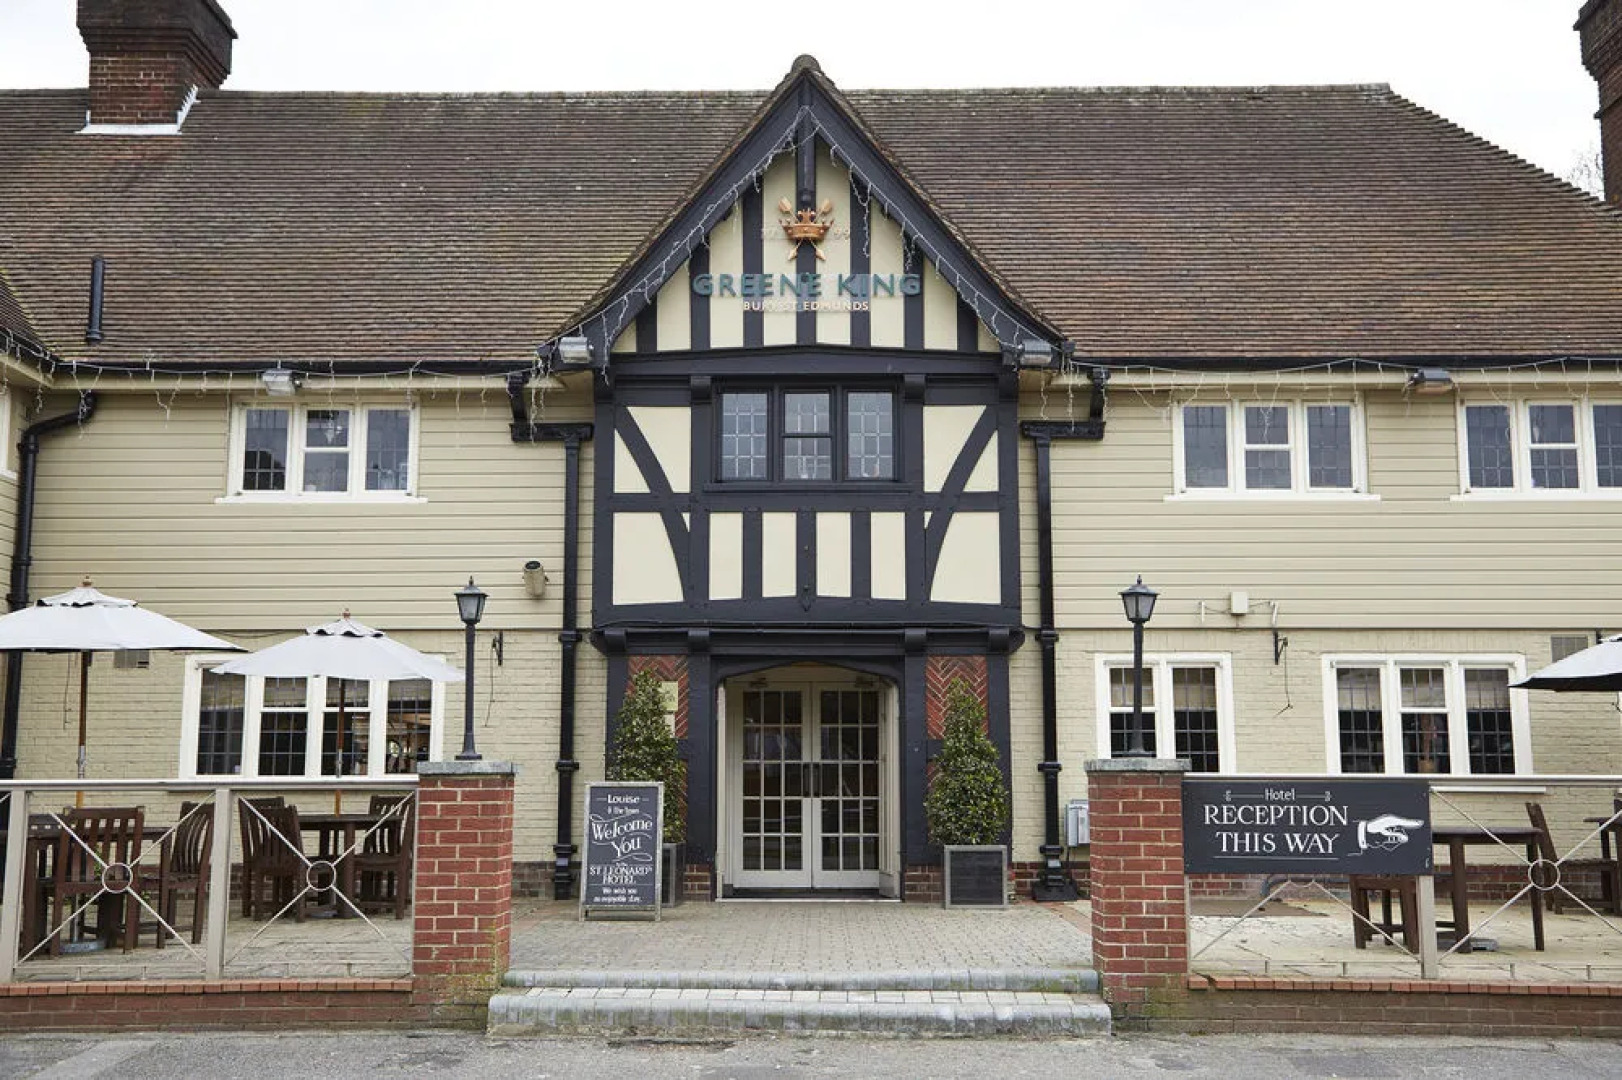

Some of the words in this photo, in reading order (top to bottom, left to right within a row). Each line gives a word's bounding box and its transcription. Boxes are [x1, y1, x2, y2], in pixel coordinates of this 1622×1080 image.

[692, 273, 822, 297] GREENE
[838, 273, 921, 297] KING
[803, 302, 869, 311] EDMUNDS
[607, 794, 640, 804] Louise
[1264, 788, 1296, 801] Hotel
[1204, 805, 1349, 826] RECEPTION
[592, 820, 653, 840] Welcome
[610, 837, 642, 858] You
[1215, 832, 1276, 852] THIS
[1284, 833, 1340, 854] WAY
